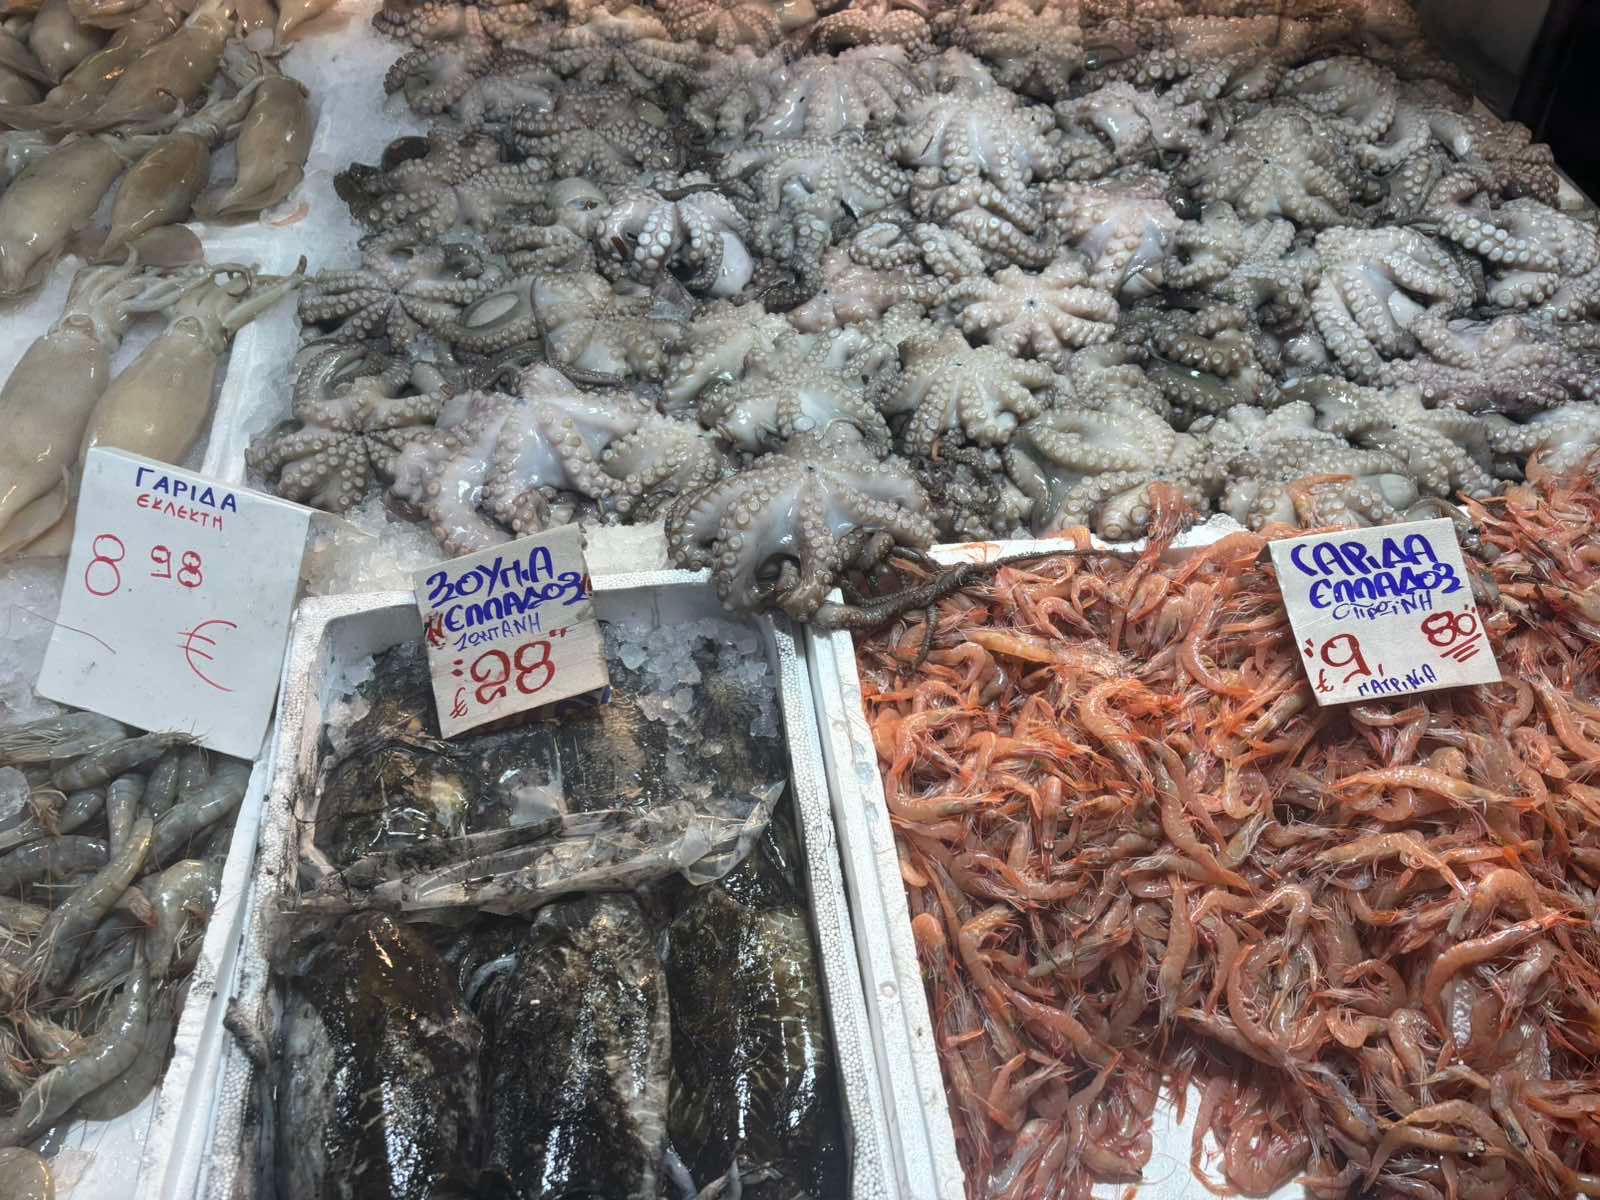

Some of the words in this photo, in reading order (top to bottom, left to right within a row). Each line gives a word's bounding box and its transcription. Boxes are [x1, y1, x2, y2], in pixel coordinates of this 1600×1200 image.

[135, 467, 237, 512] ΓΑΡΙΔΑ
[136, 493, 223, 531] ΕΚΛΕΚΤΗ
[85, 534, 125, 596] 8
[150, 545, 203, 588] 98
[1290, 534, 1438, 576] ΓΑΡΙΔΑ
[176, 620, 237, 692] €
